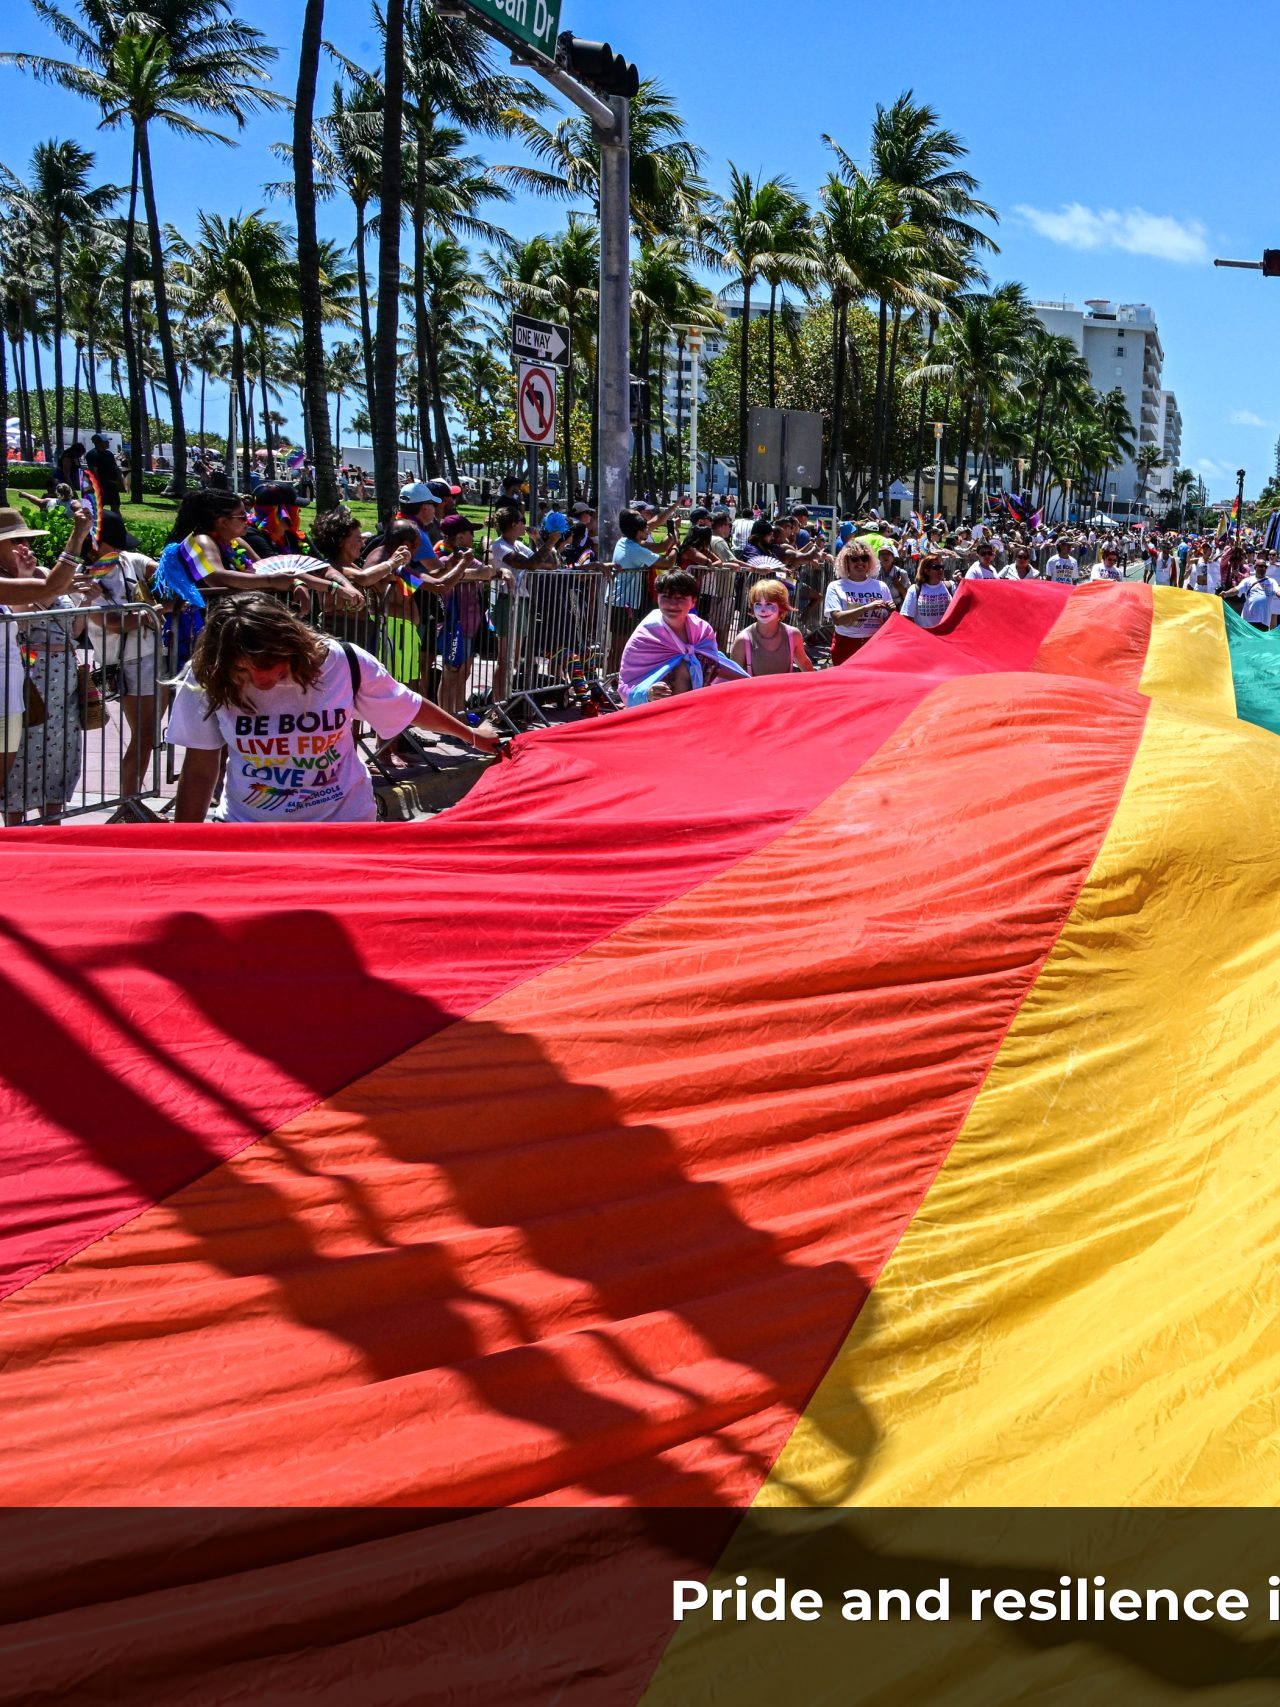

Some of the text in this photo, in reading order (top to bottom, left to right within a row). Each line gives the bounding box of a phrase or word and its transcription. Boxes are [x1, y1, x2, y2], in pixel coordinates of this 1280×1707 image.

[533, 0, 554, 43] Dr
[518, 328, 550, 349] ONE WAY
[235, 708, 347, 736] BE BOLD
[235, 737, 291, 756] LIVE
[292, 745, 342, 770] WOKE
